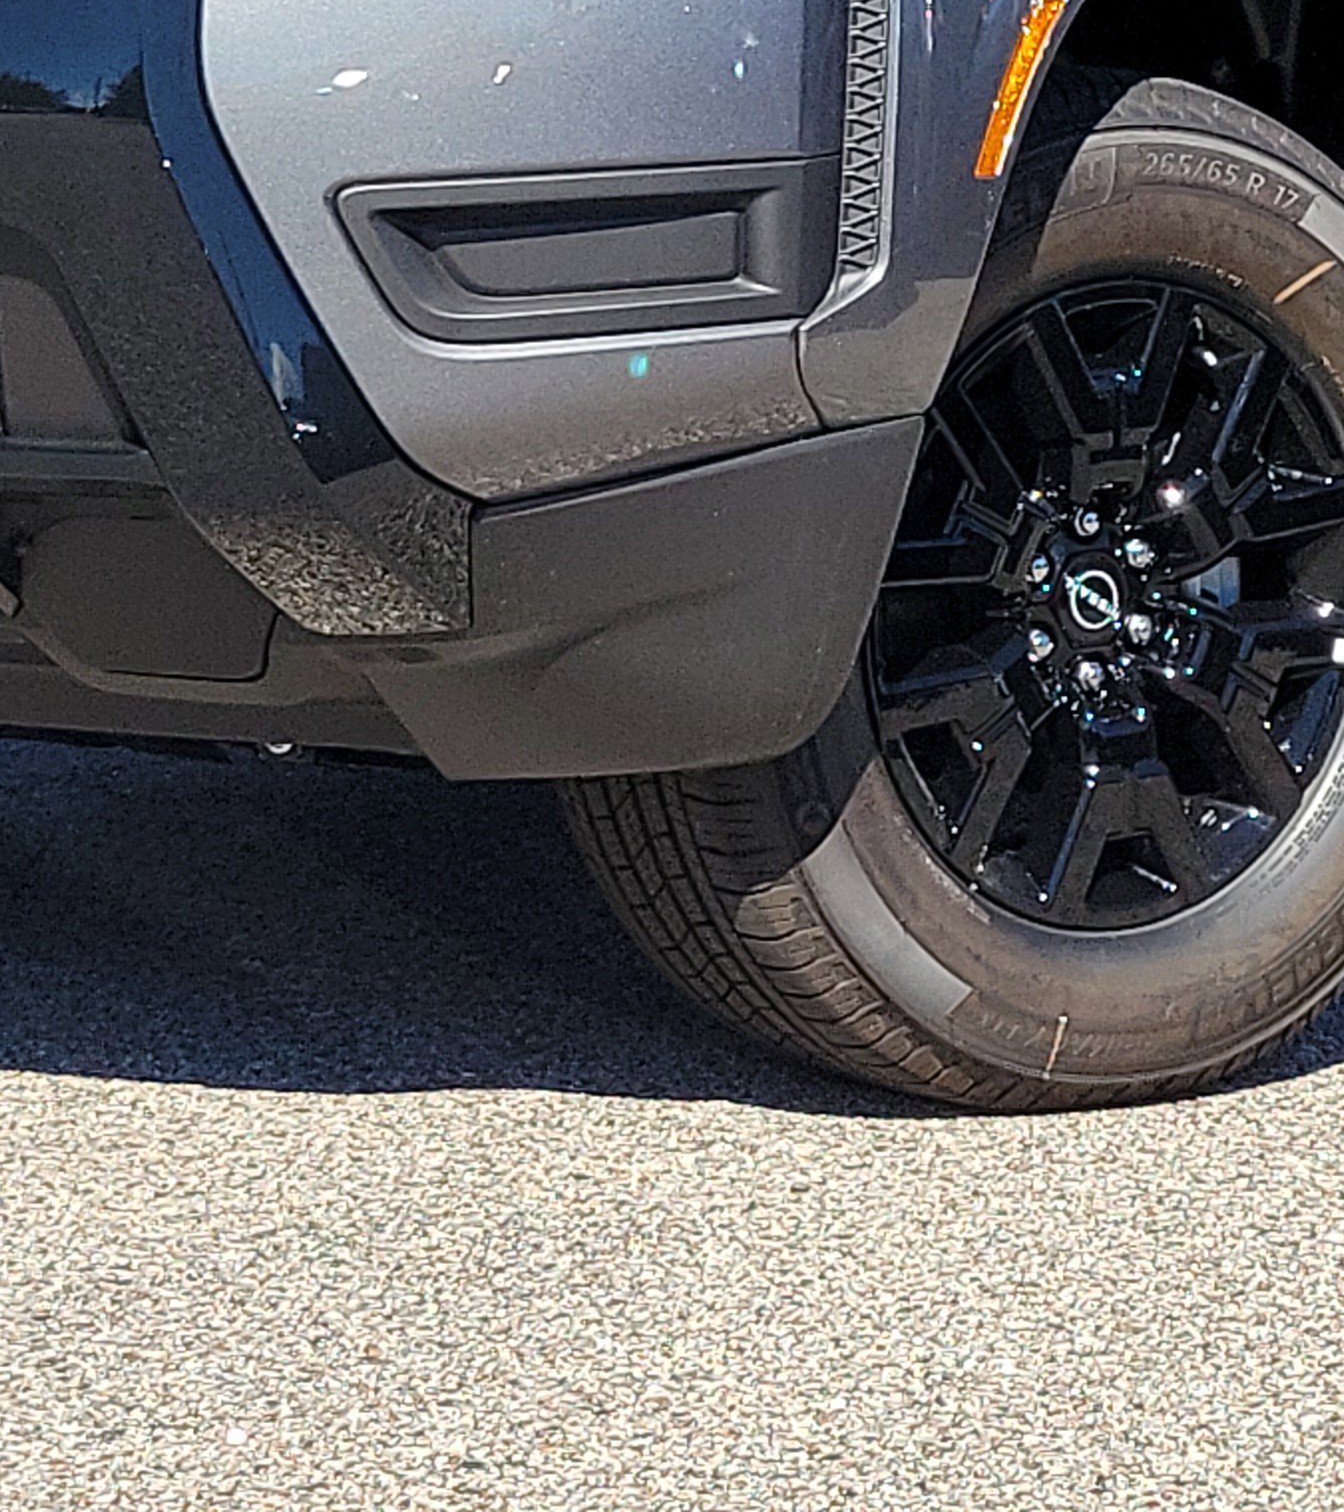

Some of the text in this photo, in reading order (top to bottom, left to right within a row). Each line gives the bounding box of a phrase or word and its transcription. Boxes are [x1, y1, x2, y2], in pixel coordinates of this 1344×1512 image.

[1142, 152, 1301, 210] 265/65 R 17
